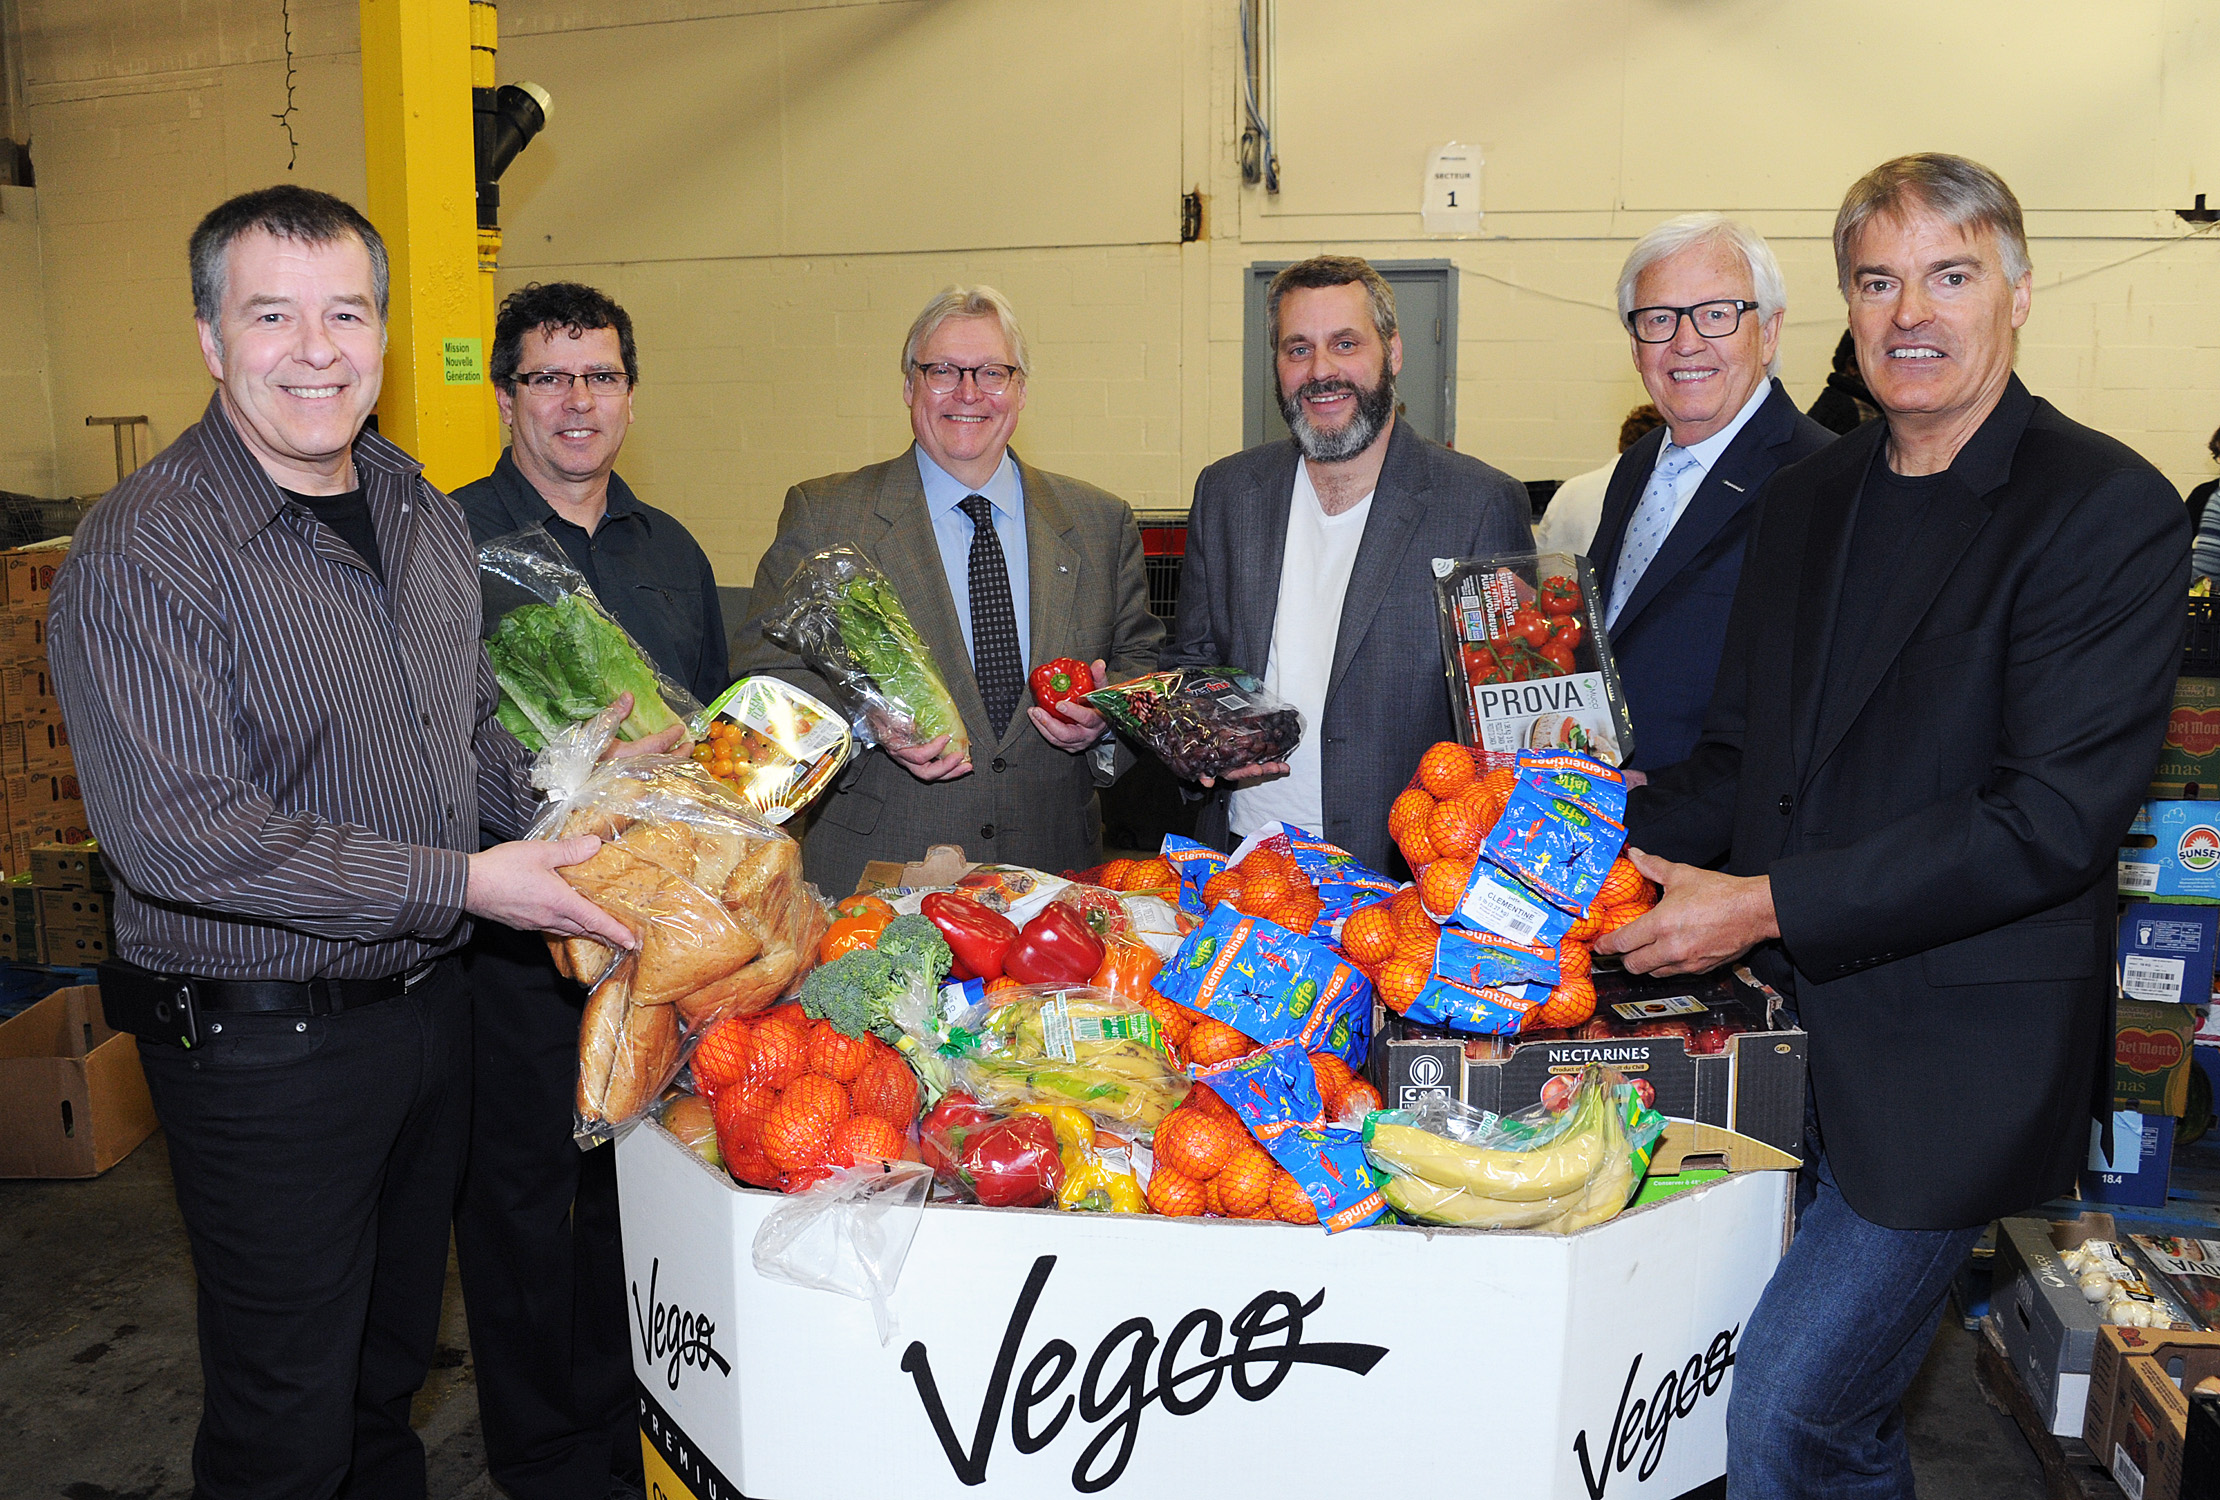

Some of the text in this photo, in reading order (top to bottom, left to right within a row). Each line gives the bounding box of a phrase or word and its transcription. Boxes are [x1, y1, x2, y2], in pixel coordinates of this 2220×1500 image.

[1448, 191, 1458, 207] 1
[445, 343, 469, 353] Mission
[446, 357, 473, 367] Nouvelle
[446, 370, 480, 381] Génération
[1480, 573, 1499, 640] PLUS SAVOUREUSES
[1498, 572, 1515, 626] SUPERIOR TASTE
[1482, 681, 1584, 718] PROVA
[2169, 721, 2188, 733] Del
[1555, 802, 1588, 826] Jaffa
[2179, 849, 2220, 860] SUNSET
[1486, 892, 1536, 921] CLEMENTINE
[1270, 1002, 1285, 1019] love
[1286, 980, 1318, 1018] Jaffa
[1548, 1046, 1650, 1062] NECTARINES
[2118, 1040, 2178, 1056] Del Monte
[1478, 1112, 1497, 1139] Poids
[2102, 1174, 2122, 1184] 18.4
[1339, 1192, 1382, 1224] ntines
[2168, 1260, 2220, 1276] OVA
[633, 1258, 732, 1391] Vegco
[900, 1255, 1390, 1494] Vegco
[1573, 1322, 1740, 1500] Vegco
[640, 1398, 729, 1500] PREMIU
